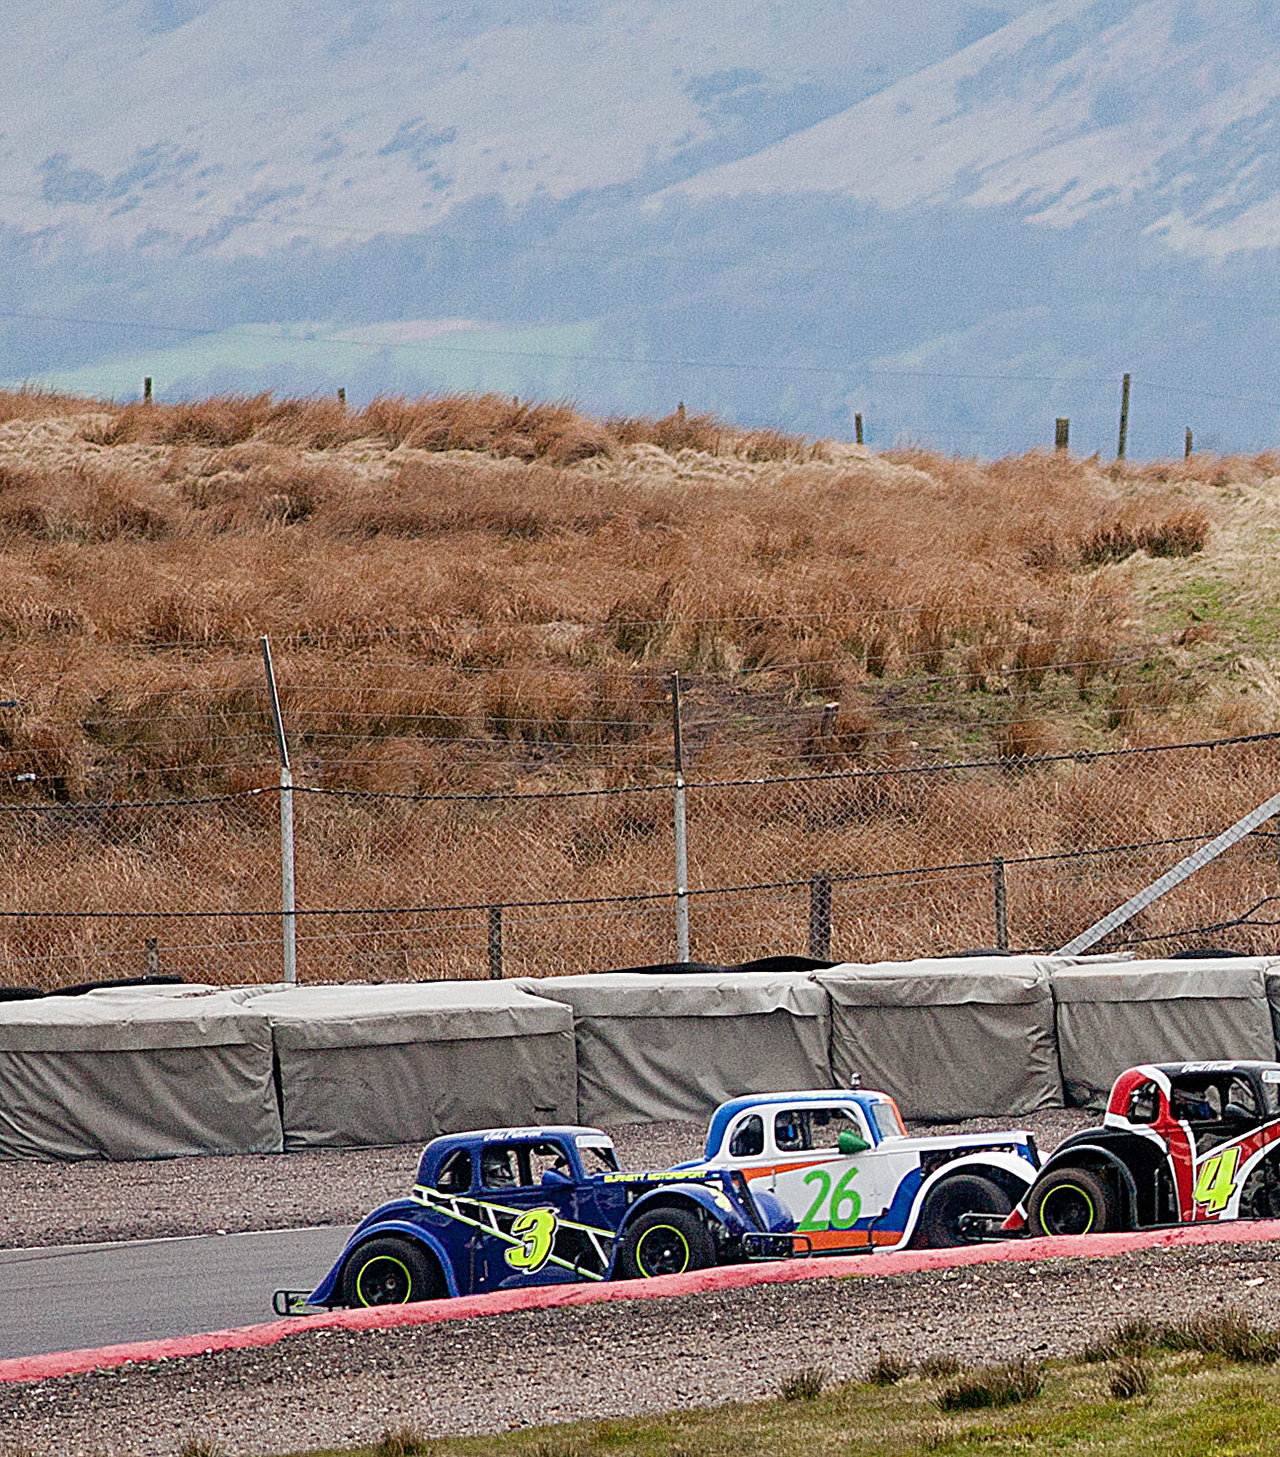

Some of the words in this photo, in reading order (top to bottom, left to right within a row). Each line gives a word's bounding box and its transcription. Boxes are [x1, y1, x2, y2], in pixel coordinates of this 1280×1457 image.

[796, 1166, 862, 1231] 26
[1193, 1145, 1241, 1217] 4
[504, 1206, 560, 1275] 3
